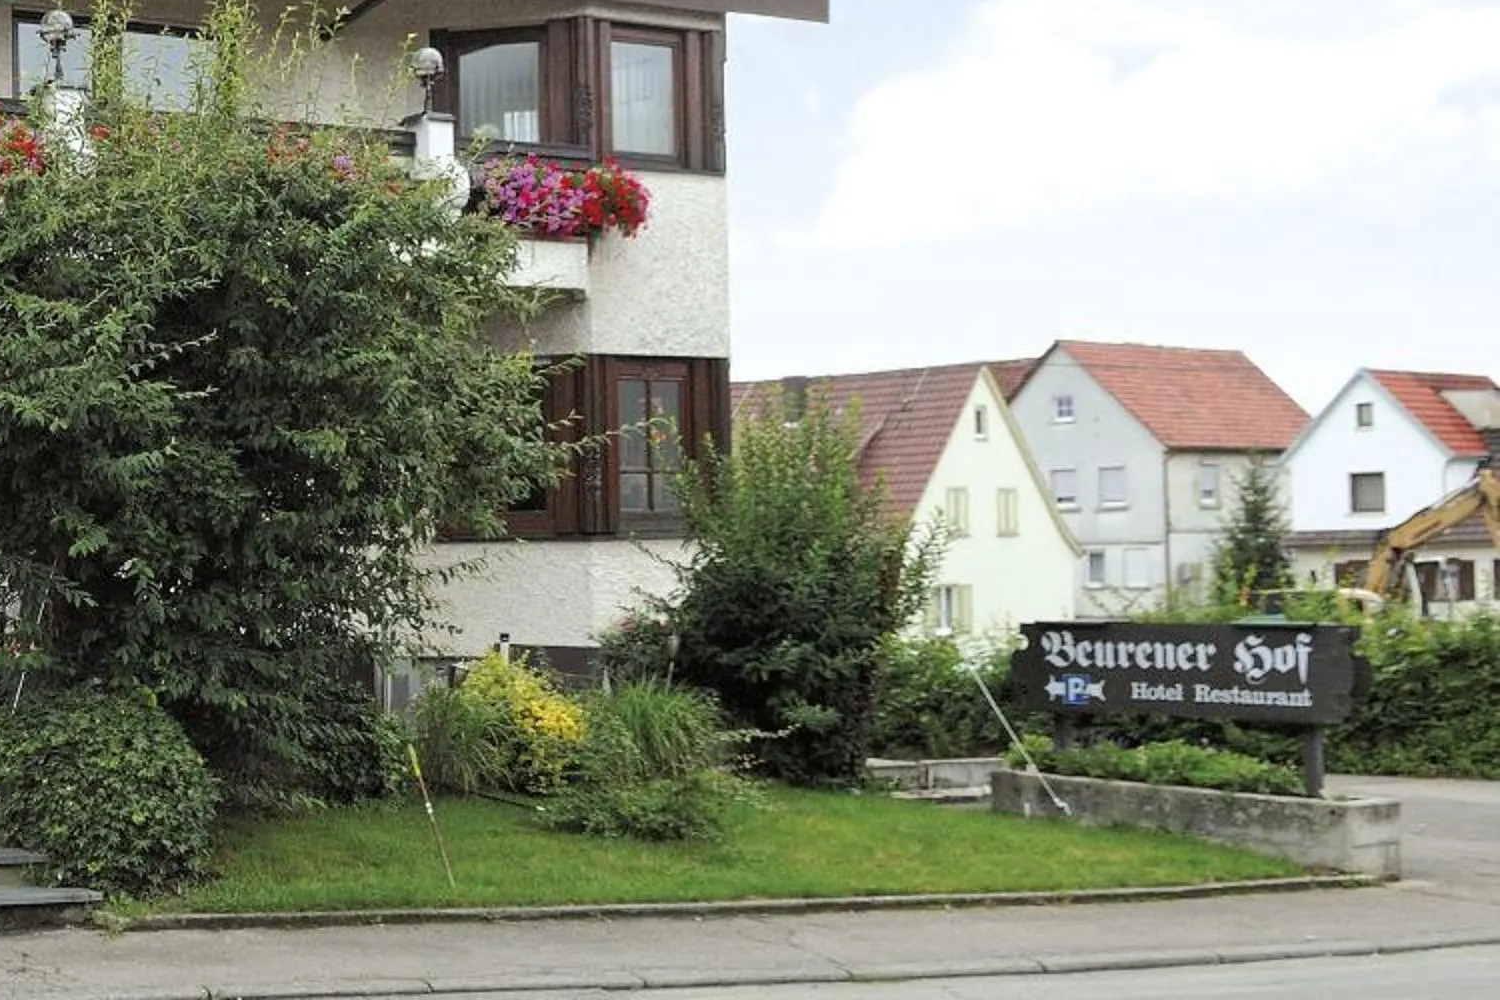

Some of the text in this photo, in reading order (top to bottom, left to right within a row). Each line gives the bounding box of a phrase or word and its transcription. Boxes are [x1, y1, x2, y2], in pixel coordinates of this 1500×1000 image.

[1041, 631, 1313, 684] Beurener Hof
[1131, 682, 1312, 707] Hotel Restaurant
